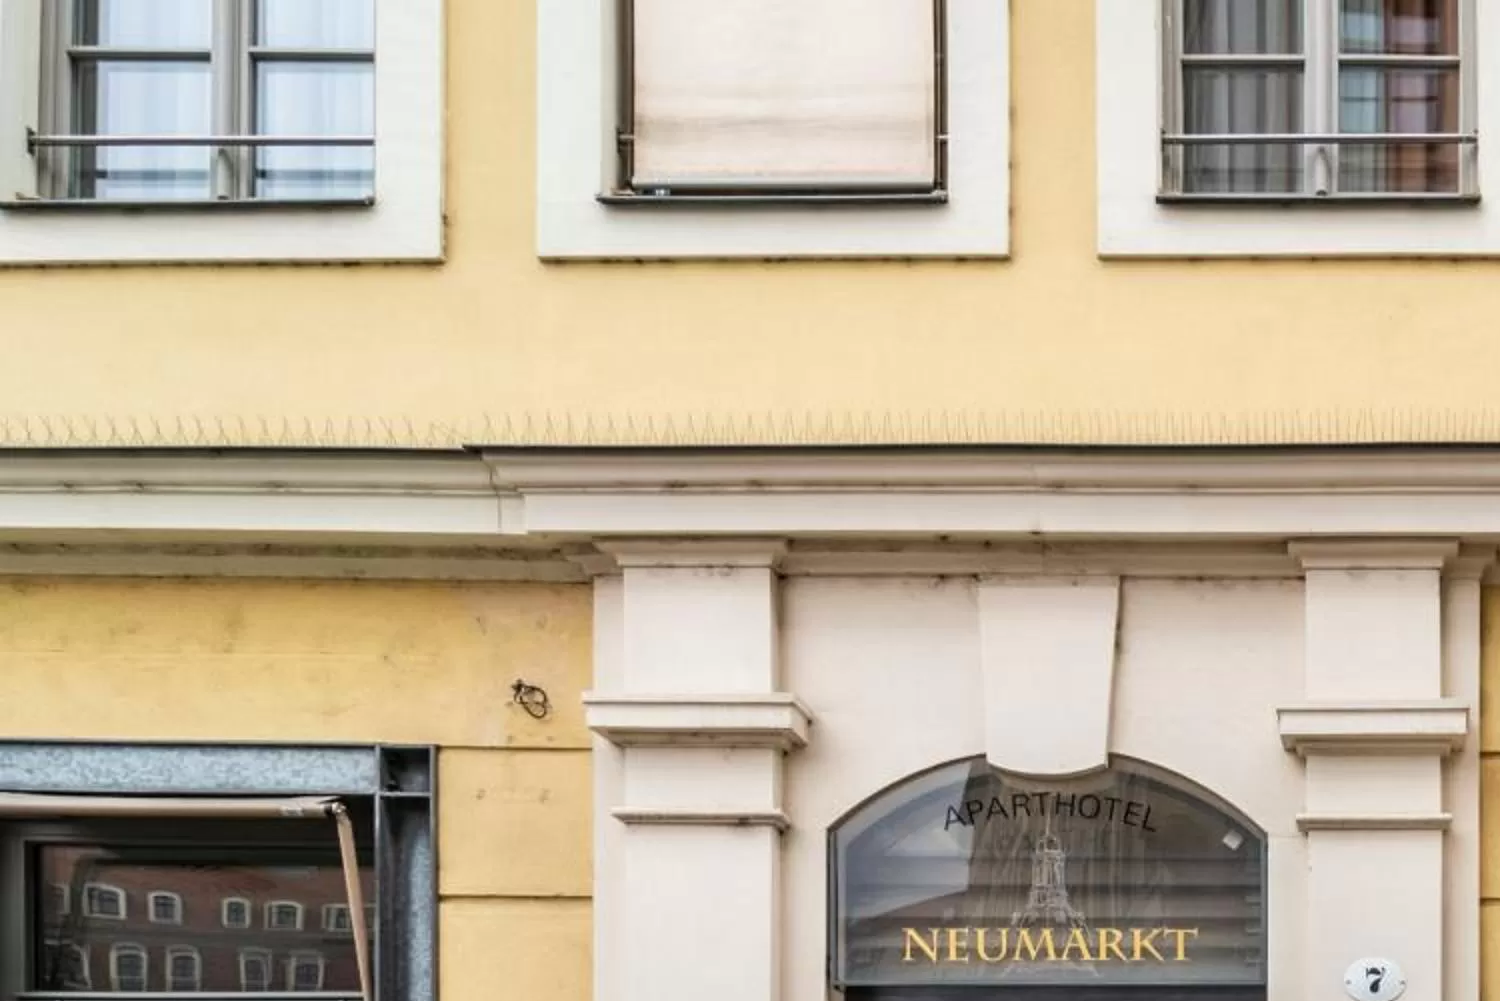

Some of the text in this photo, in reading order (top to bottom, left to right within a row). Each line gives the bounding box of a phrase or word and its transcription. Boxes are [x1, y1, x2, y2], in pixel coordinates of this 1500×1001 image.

[942, 791, 1158, 832] APARTHOTEL
[902, 926, 1199, 963] NEUMARKT
[1365, 966, 1386, 994] 7
